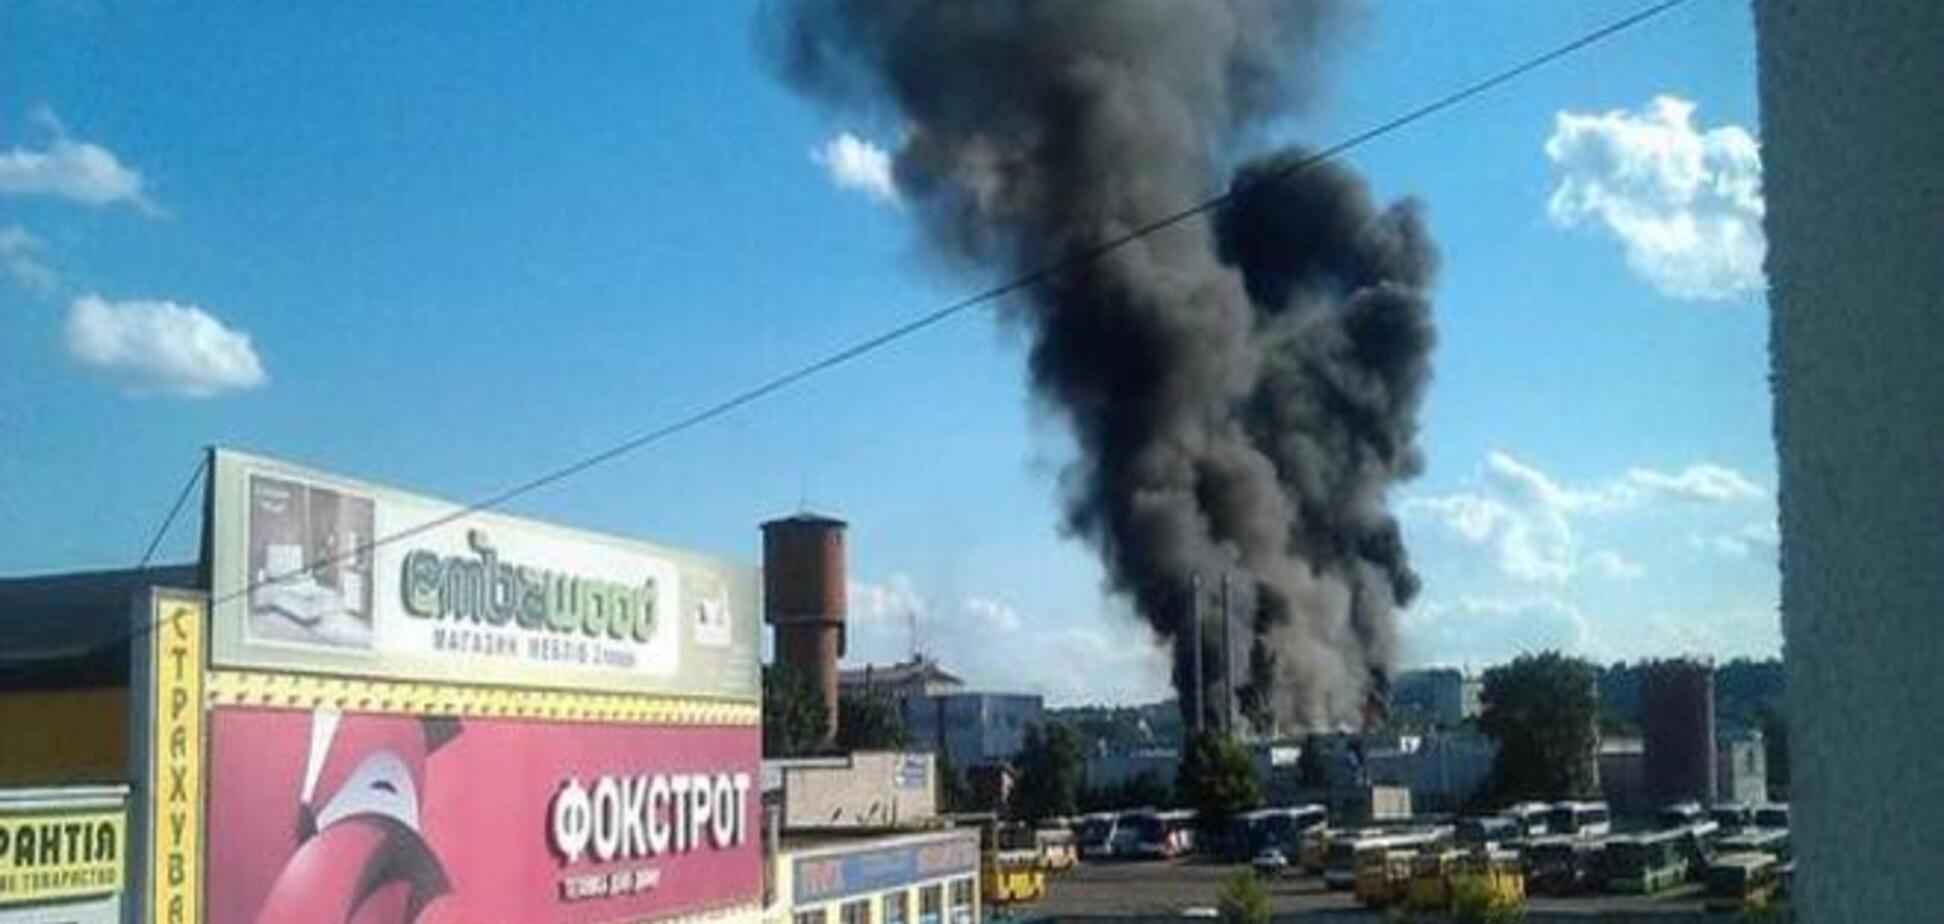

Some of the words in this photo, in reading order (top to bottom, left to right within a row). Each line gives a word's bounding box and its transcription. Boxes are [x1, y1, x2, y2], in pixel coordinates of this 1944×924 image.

[401, 529, 656, 643] embawood
[433, 629, 517, 655] МАГАЗИН
[550, 772, 750, 864] ФОКСТРОТ
